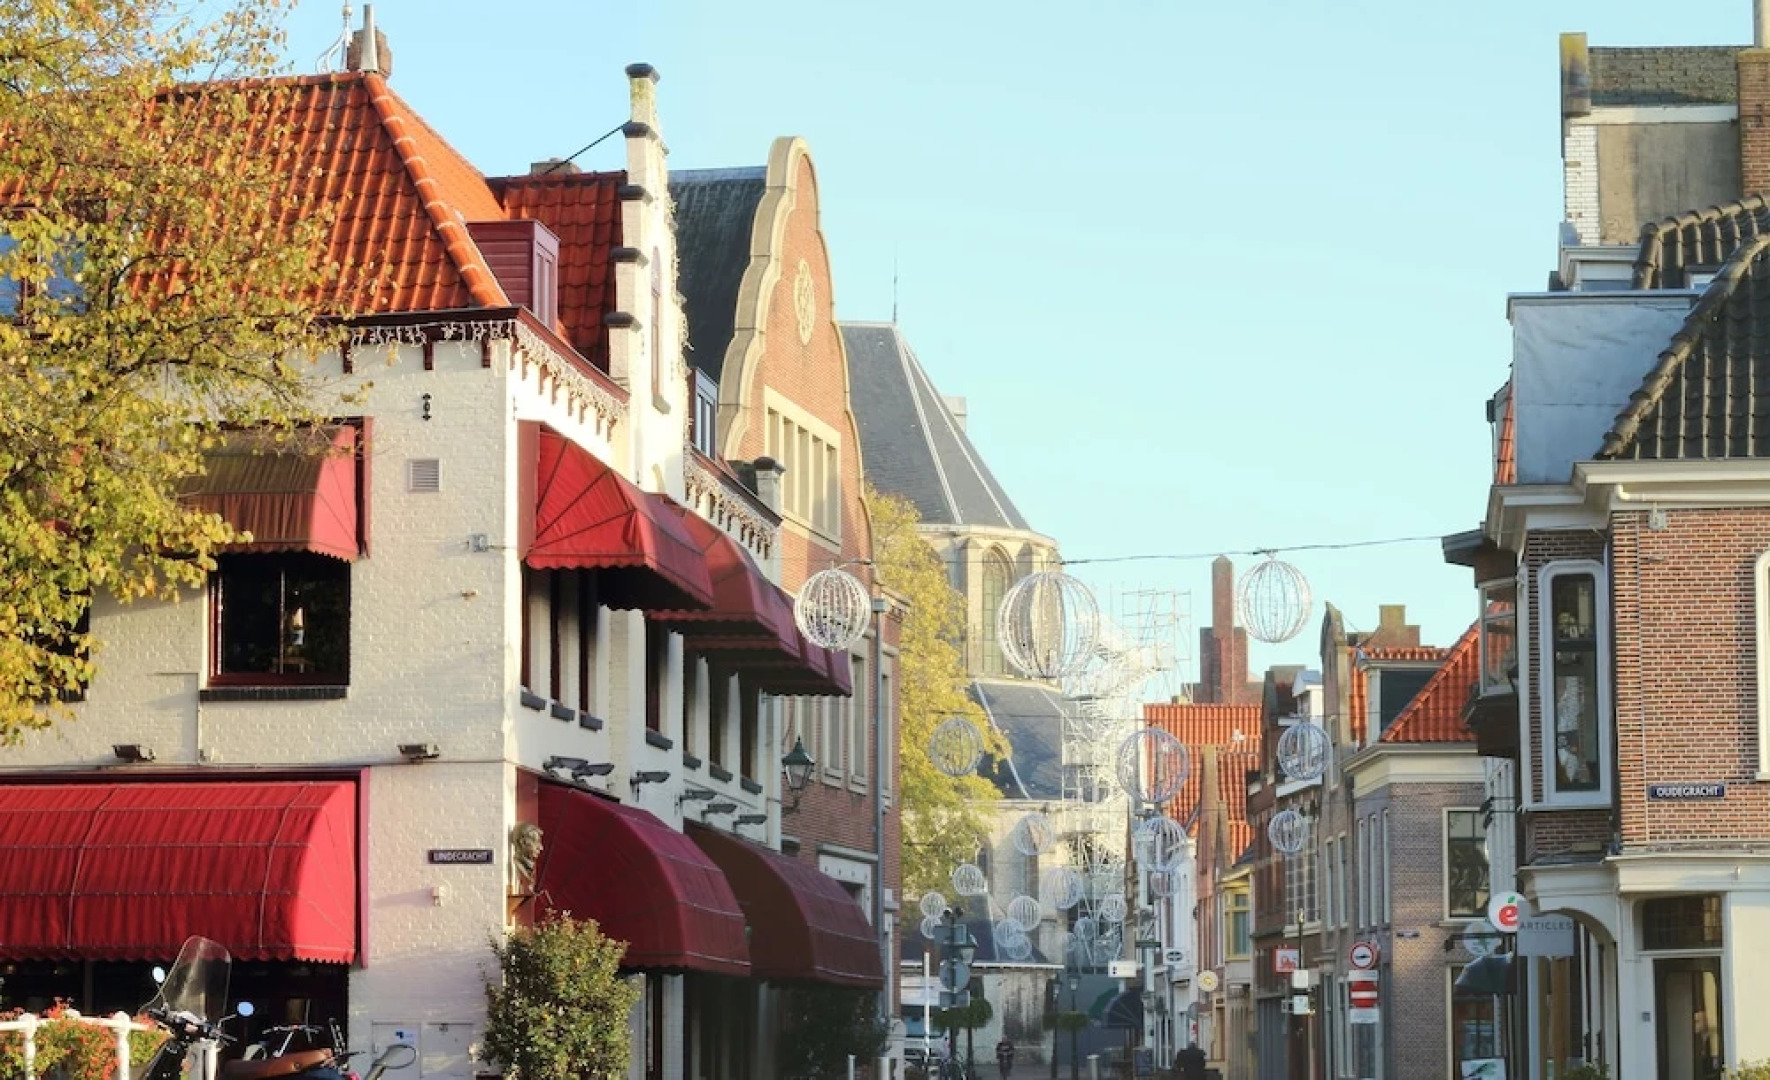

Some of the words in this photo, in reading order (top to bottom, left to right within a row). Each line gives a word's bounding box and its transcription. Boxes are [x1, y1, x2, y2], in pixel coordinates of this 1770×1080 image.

[1656, 786, 1718, 798] OUDEGRACHT
[433, 851, 487, 861] LINDEGRACHT
[1519, 921, 1573, 931] ARTICLES
